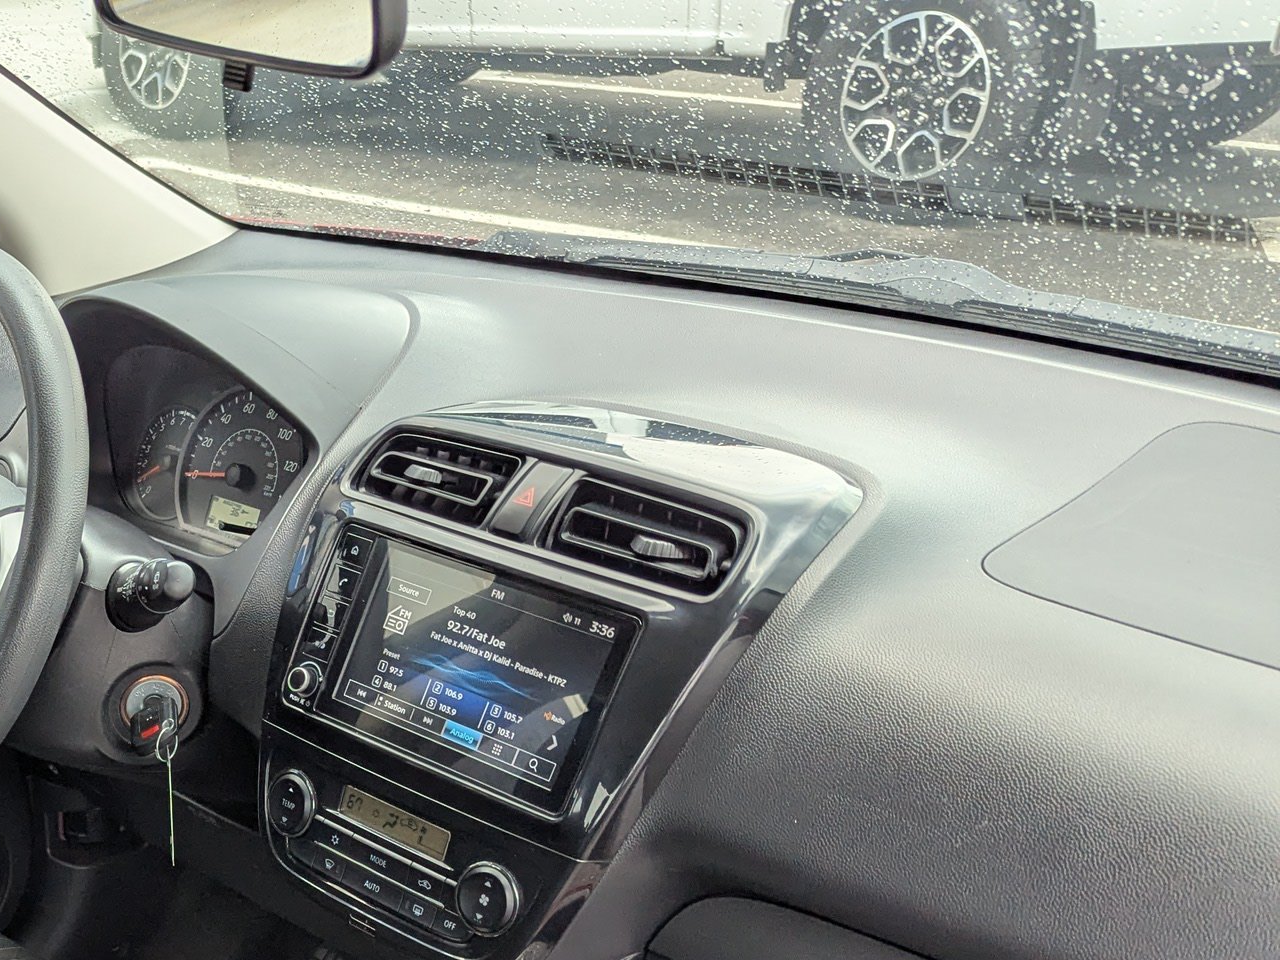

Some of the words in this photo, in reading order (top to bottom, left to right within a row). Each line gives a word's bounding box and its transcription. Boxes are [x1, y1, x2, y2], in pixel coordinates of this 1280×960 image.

[243, 403, 255, 414] 60
[220, 414, 232, 424] 40
[277, 427, 293, 441] 100
[201, 436, 213, 448] 20
[283, 460, 298, 473] 120
[145, 485, 152, 494] 0
[398, 584, 420, 597] Source
[491, 589, 505, 601] FM
[399, 609, 412, 620] FM
[453, 606, 466, 618] Top
[466, 611, 476, 620] 40
[447, 620, 489, 643] 92.7/Fat
[488, 635, 506, 649] Joe
[589, 621, 615, 638] 3:36
[383, 648, 401, 660] Preset
[430, 631, 440, 641] Fat
[440, 635, 452, 645] Joe
[458, 641, 478, 655] Anitta
[484, 650, 493, 662] Dj
[492, 653, 511, 667] Kalid
[514, 662, 543, 679] Paradise
[389, 666, 404, 677] 97.5
[383, 681, 397, 692] 88.1
[445, 687, 463, 701] 106.9
[383, 700, 406, 715] Station
[438, 703, 457, 716] 103.9
[503, 711, 523, 724] 105.7
[449, 727, 474, 745] Analog
[497, 726, 515, 740] 103.1
[281, 797, 296, 811] TEMP
[370, 854, 386, 868] MODE
[363, 879, 380, 893] AUTO
[443, 919, 456, 931] OFF
